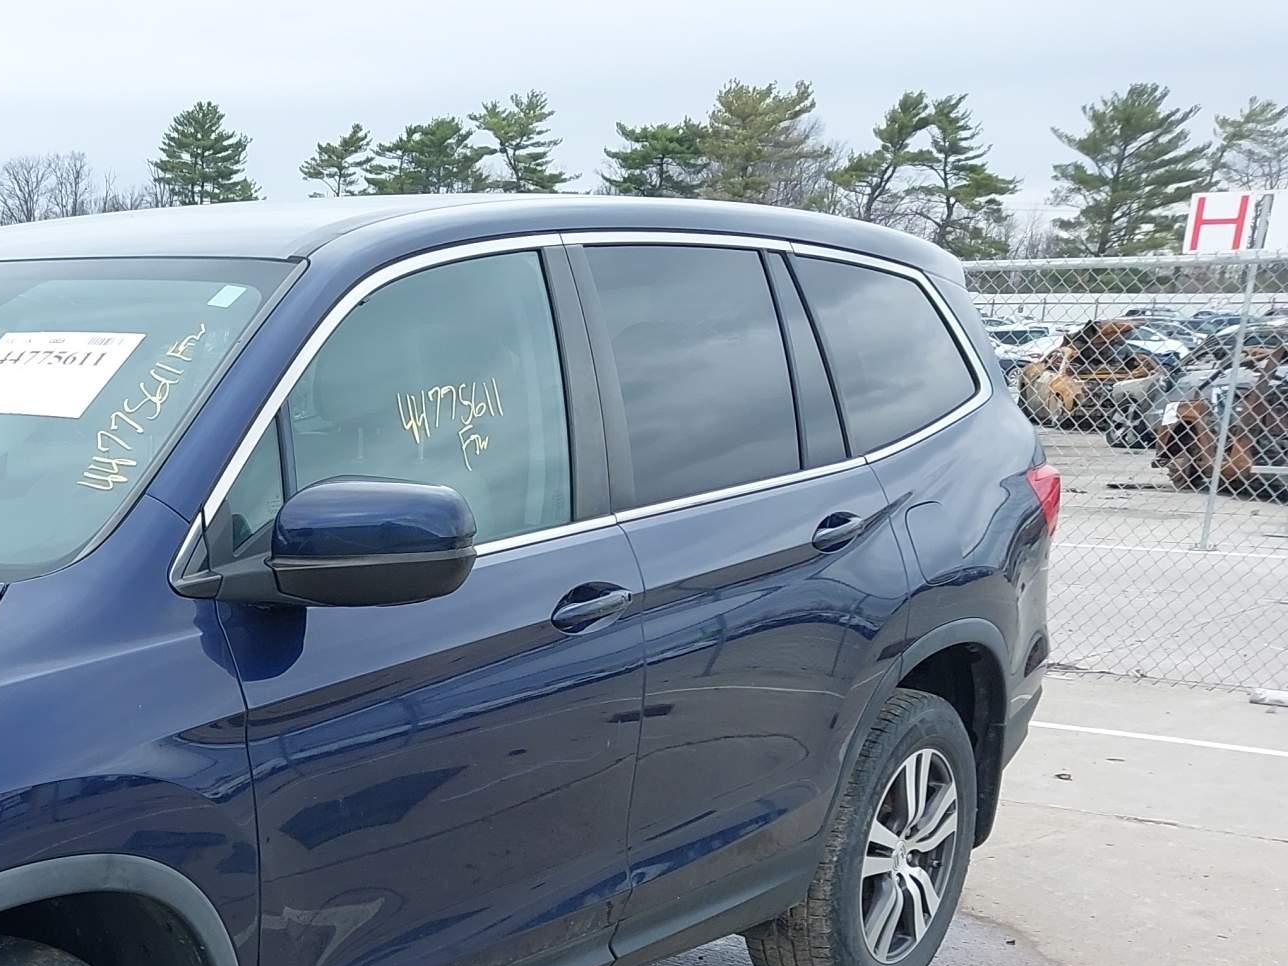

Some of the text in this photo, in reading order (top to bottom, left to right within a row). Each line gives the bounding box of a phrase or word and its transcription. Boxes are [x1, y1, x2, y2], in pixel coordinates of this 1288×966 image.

[1189, 195, 1250, 251] H
[76, 362, 185, 490] 44775611
[397, 377, 504, 445] 44775611
